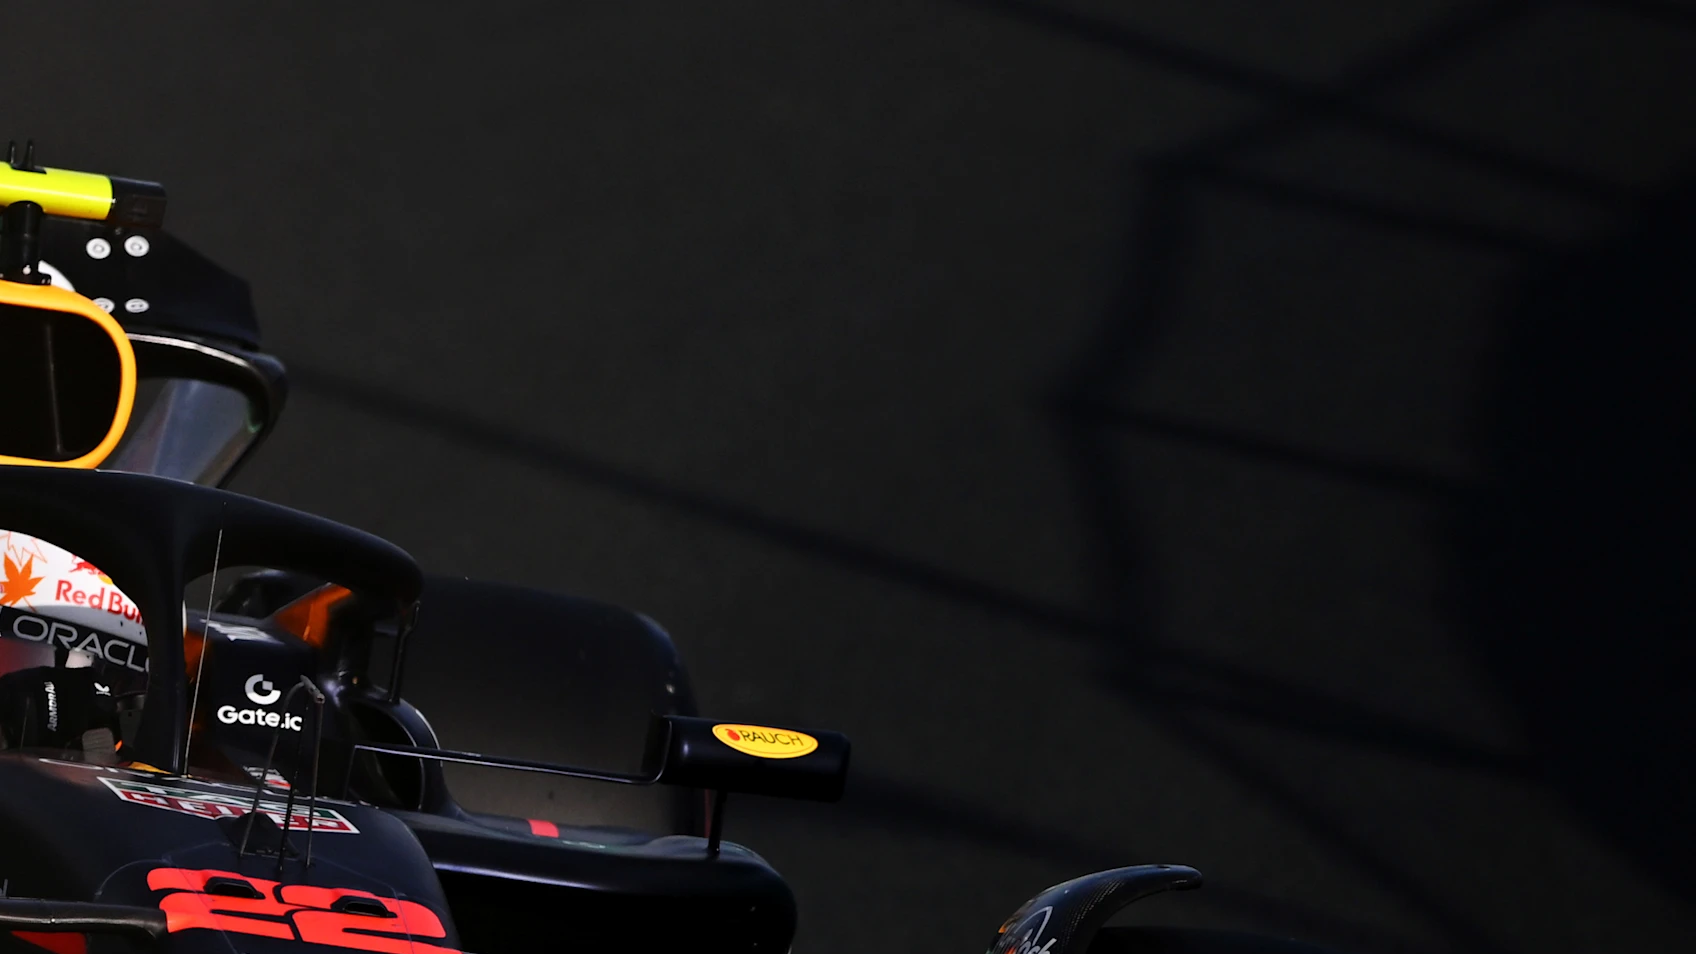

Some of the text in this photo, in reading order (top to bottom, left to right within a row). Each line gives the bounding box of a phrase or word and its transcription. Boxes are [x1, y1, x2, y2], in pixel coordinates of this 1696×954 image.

[55, 579, 105, 611] Red
[12, 614, 150, 673] ORACL
[738, 729, 804, 747] RAUCH
